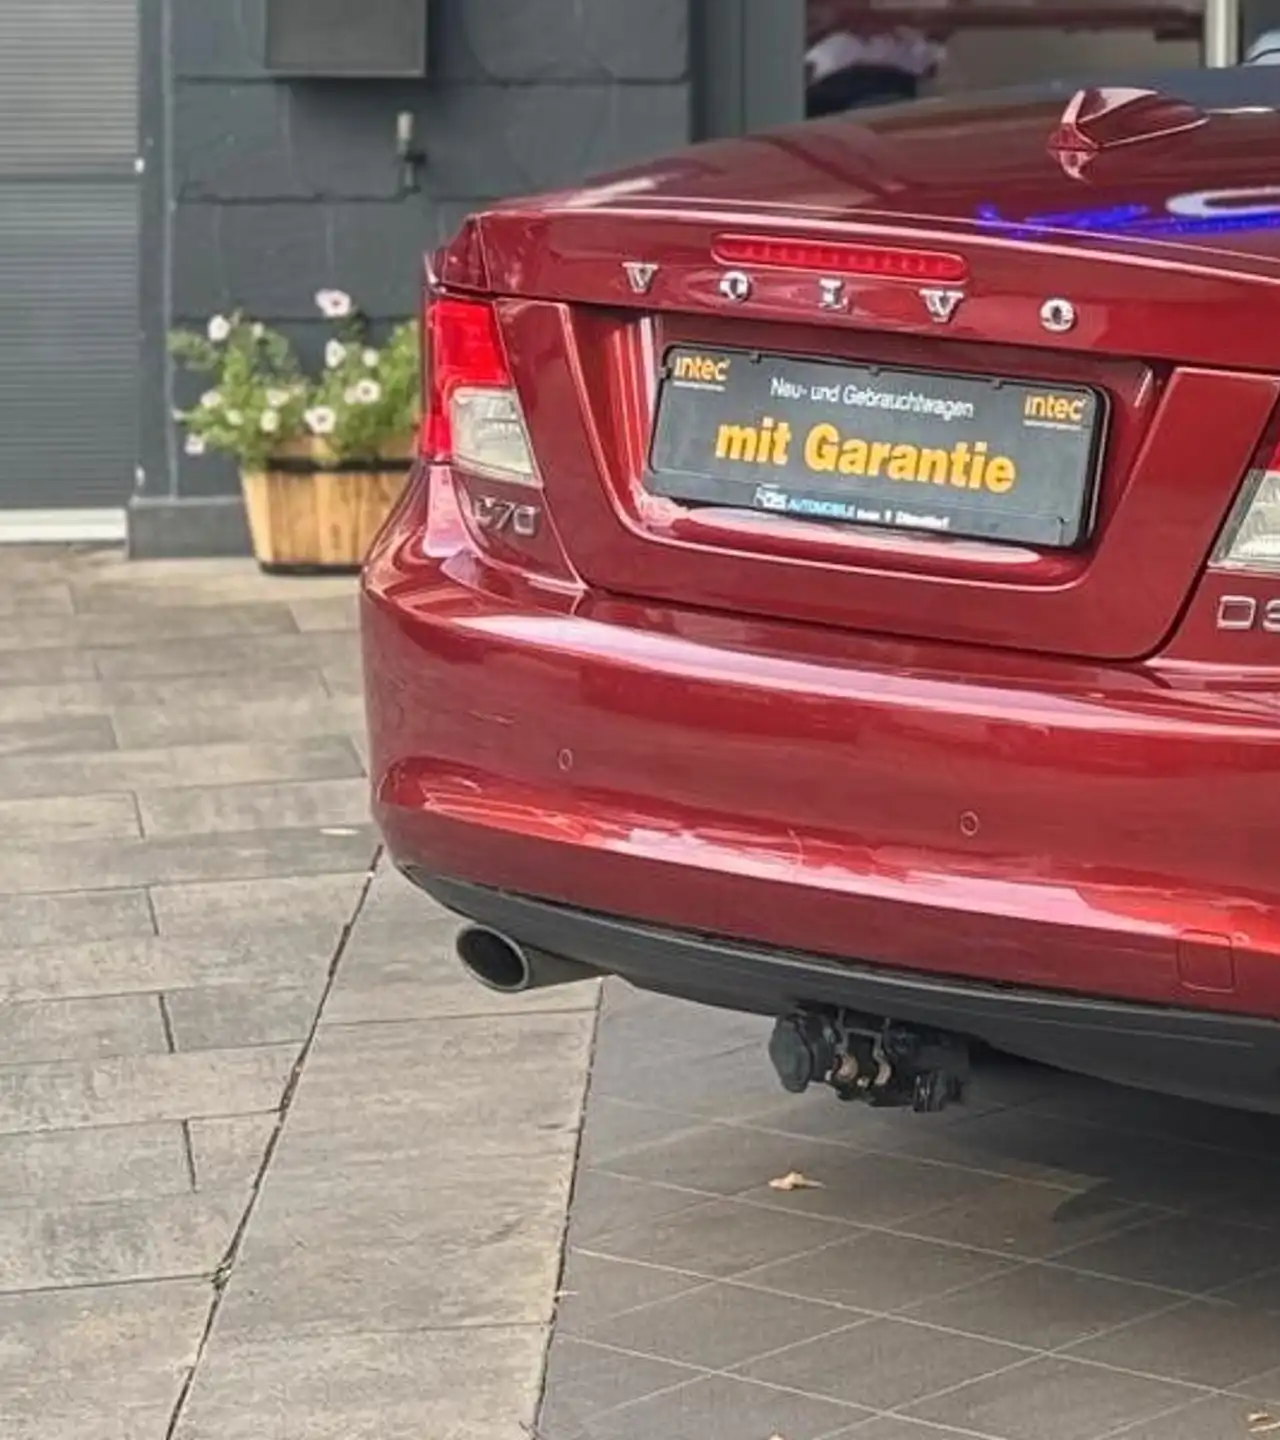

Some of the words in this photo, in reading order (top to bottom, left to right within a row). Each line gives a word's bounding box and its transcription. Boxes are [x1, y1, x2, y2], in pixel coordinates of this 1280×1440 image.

[621, 261, 1077, 333] VOLVO
[674, 356, 731, 382] intec
[769, 375, 808, 399] Neu-
[810, 383, 842, 403] und
[842, 384, 975, 421] Gebrauchtwagen
[1024, 393, 1086, 421] intec
[715, 416, 793, 465] mit
[804, 422, 1017, 494] Garantie
